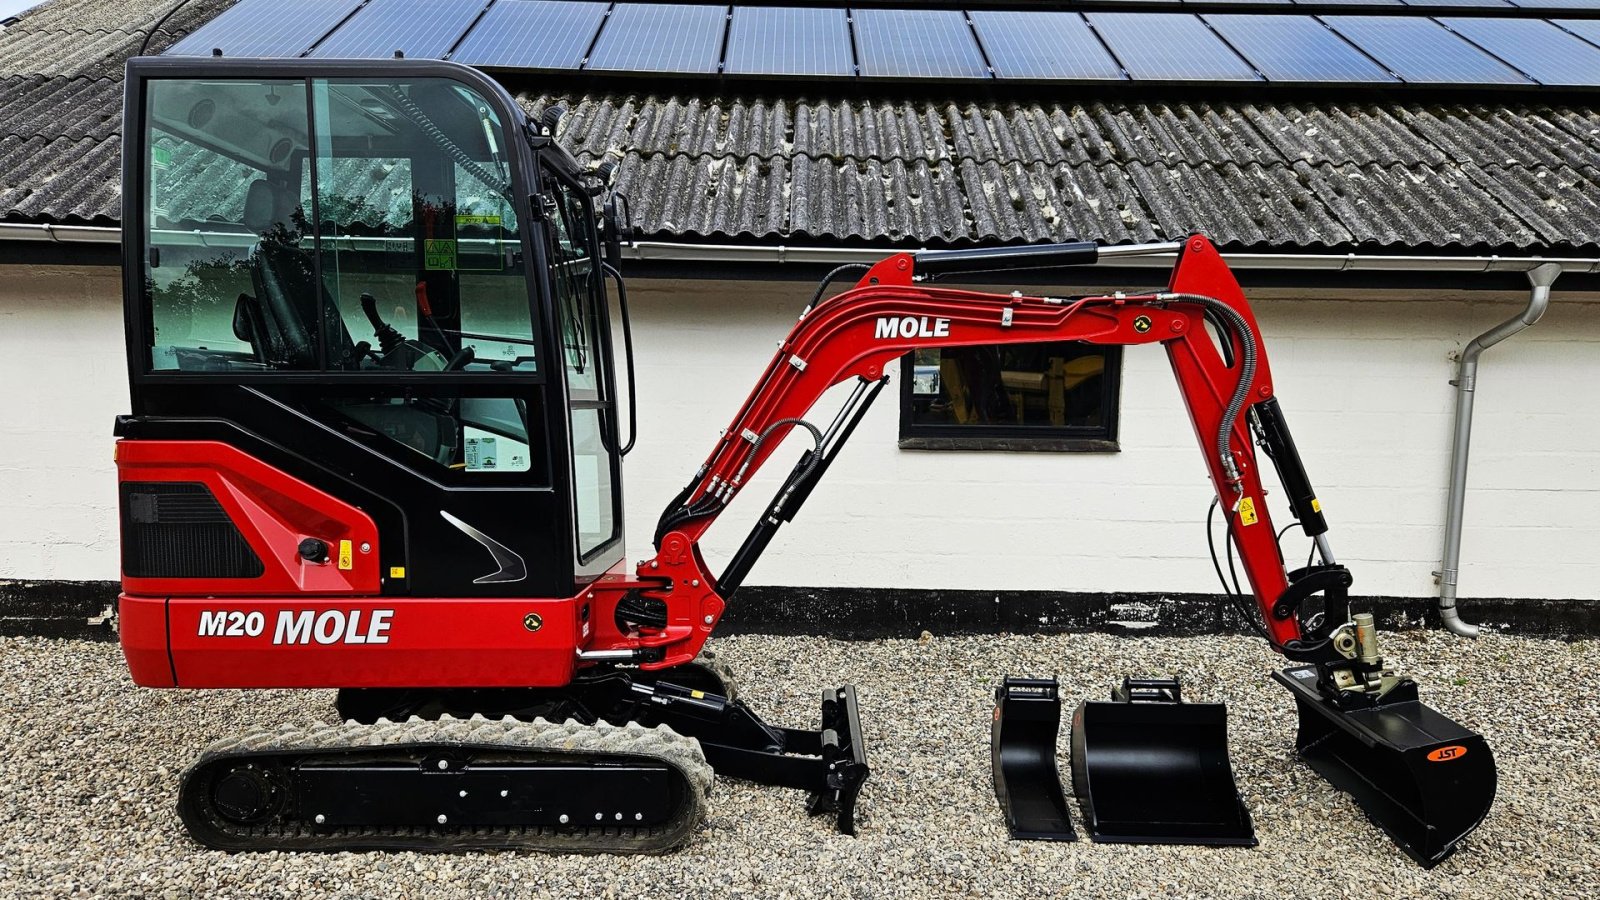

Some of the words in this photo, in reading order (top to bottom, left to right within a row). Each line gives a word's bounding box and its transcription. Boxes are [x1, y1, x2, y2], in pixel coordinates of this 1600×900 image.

[874, 316, 951, 339] MOLE
[198, 610, 265, 637] M20
[272, 609, 395, 645] MOLE
[1437, 747, 1458, 760] JST
